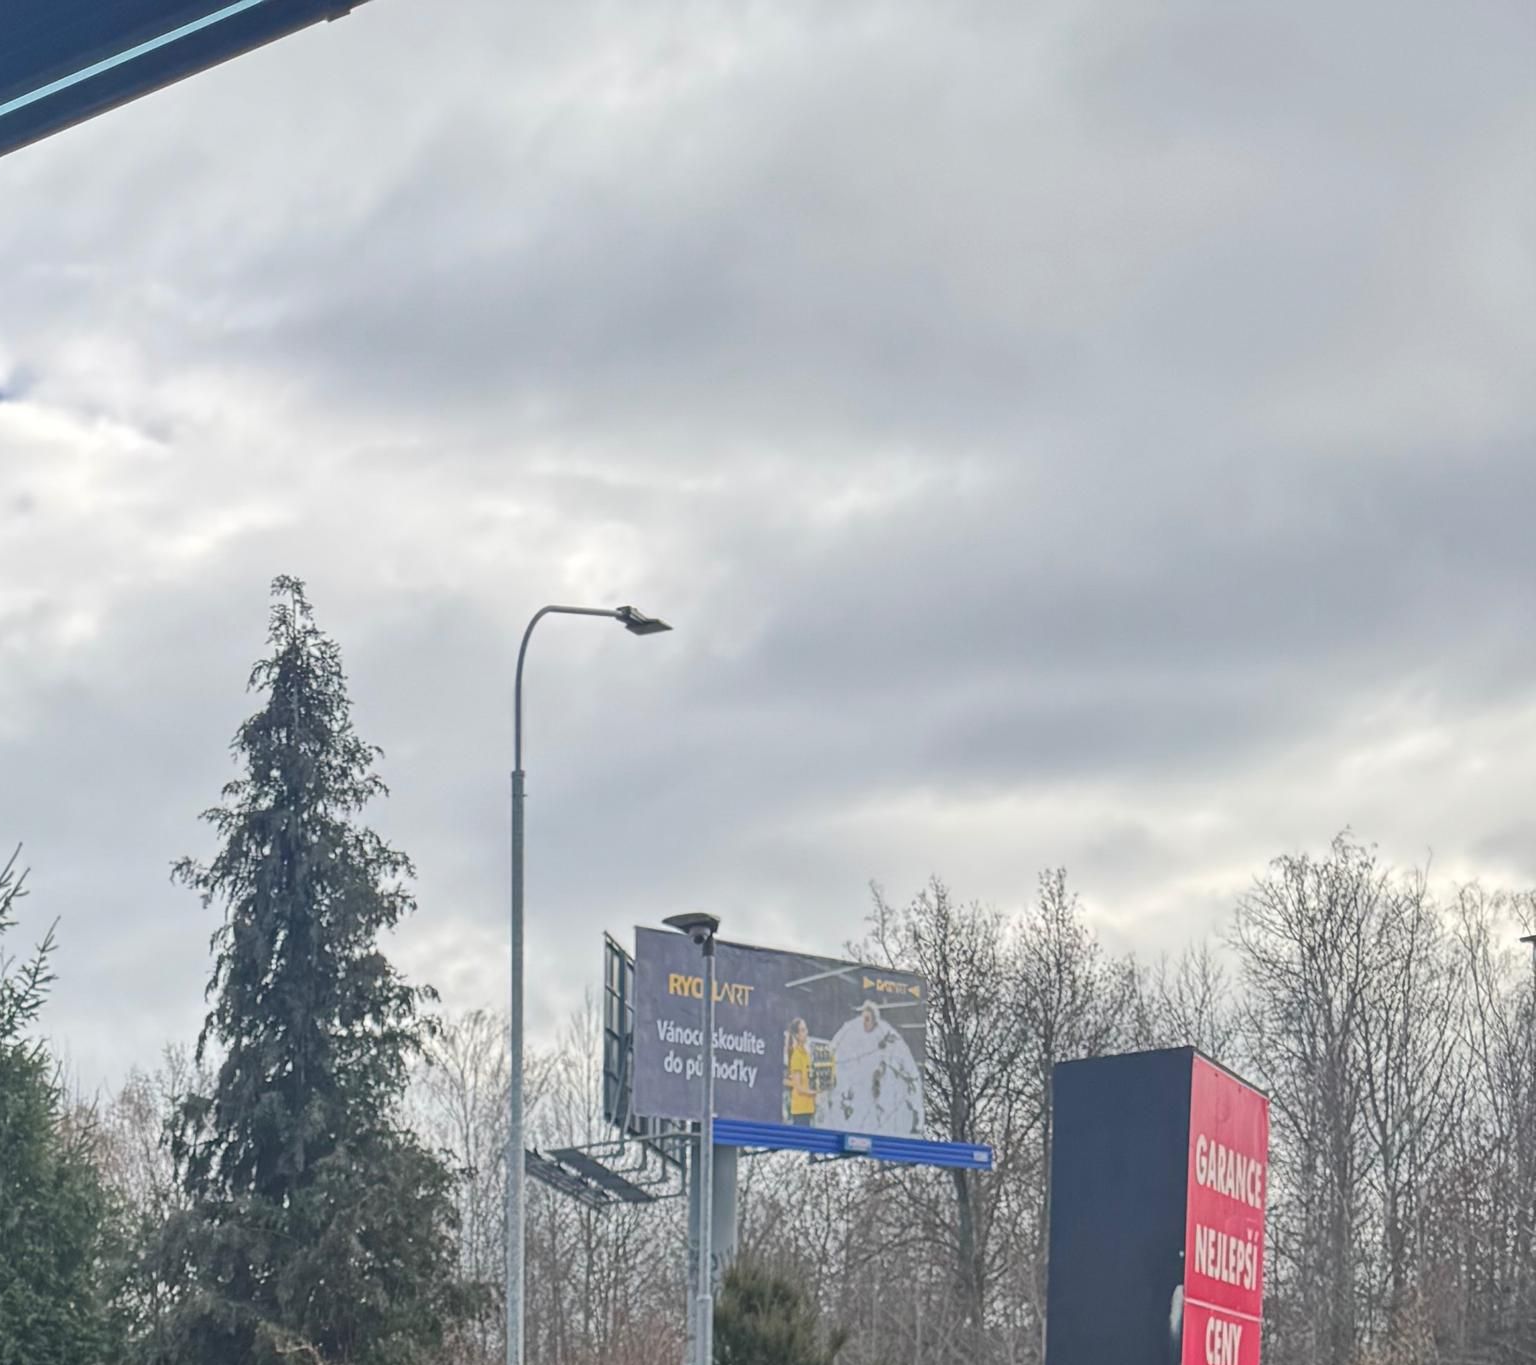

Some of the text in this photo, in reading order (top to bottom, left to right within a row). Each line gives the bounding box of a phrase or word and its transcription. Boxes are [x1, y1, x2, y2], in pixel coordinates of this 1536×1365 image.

[664, 1049, 758, 1088] do půhoďky
[1195, 1133, 1263, 1209] GARANCE
[1194, 1223, 1259, 1292] NEJLEPŠÍ
